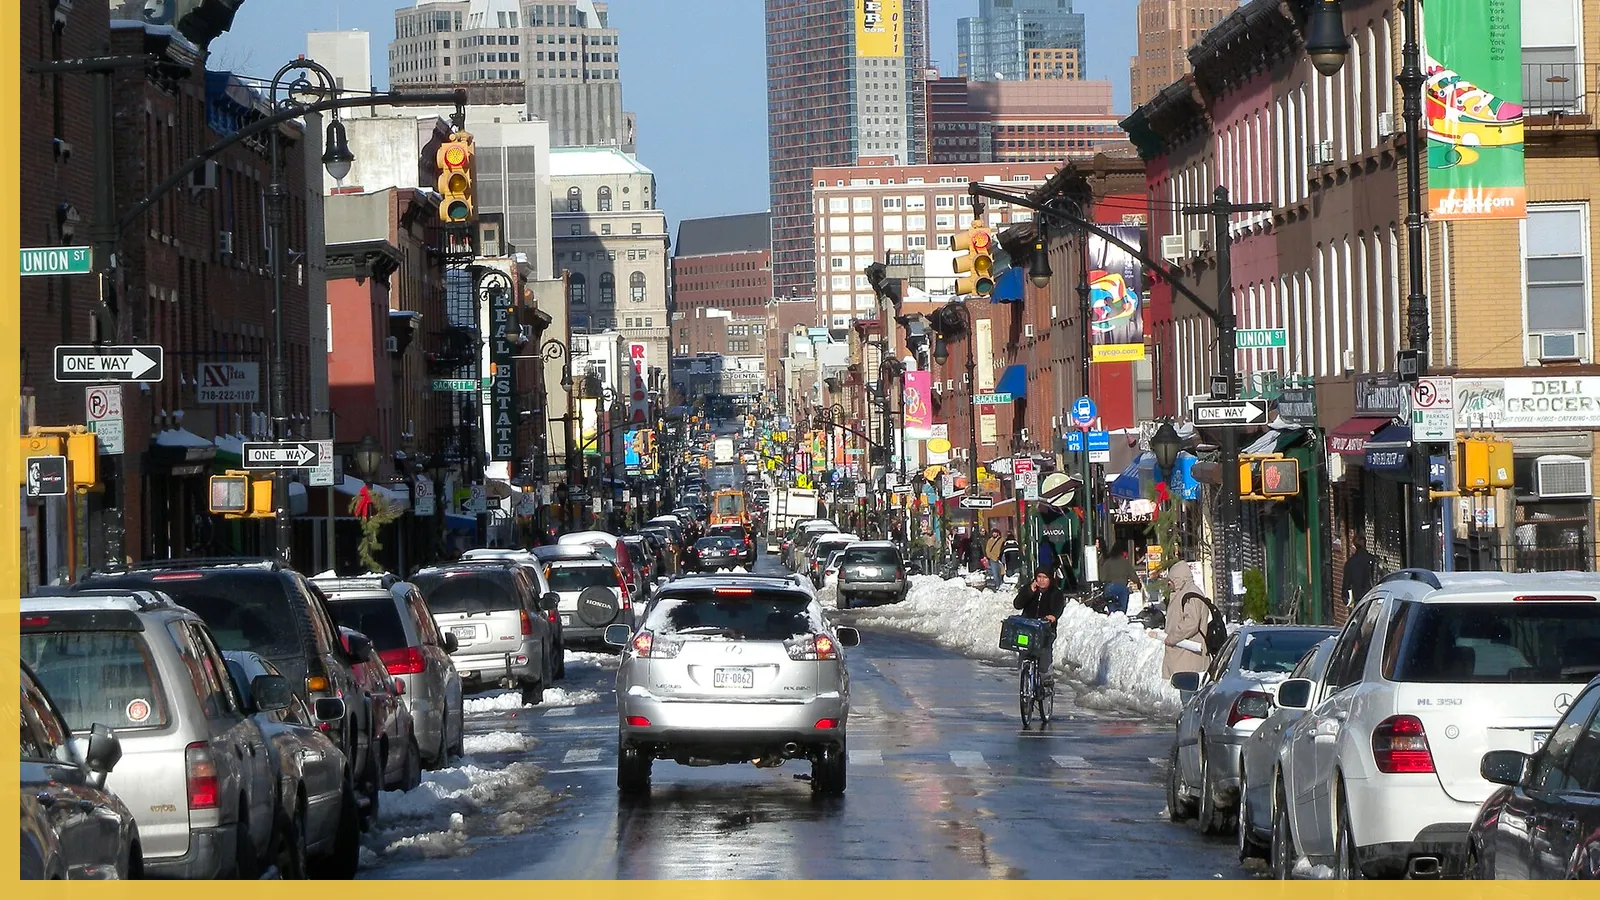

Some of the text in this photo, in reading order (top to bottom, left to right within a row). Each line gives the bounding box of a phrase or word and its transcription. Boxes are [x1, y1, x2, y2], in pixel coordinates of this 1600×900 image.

[23, 250, 85, 271] UNION ST
[1240, 331, 1284, 346] UNION ST
[1098, 348, 1138, 356] nycgo.com
[67, 357, 130, 370] ONE WAY
[494, 295, 512, 457] REAL ESTATE
[433, 381, 467, 390] SACKETT
[1532, 380, 1582, 396] DELI
[201, 390, 256, 400] 718-222-1187
[976, 394, 1004, 403] SACKETT
[1201, 407, 1245, 419] ONE WAY
[254, 450, 308, 460] ONE WAY
[585, 599, 612, 610] HONDA
[715, 672, 751, 684] DZF-0862
